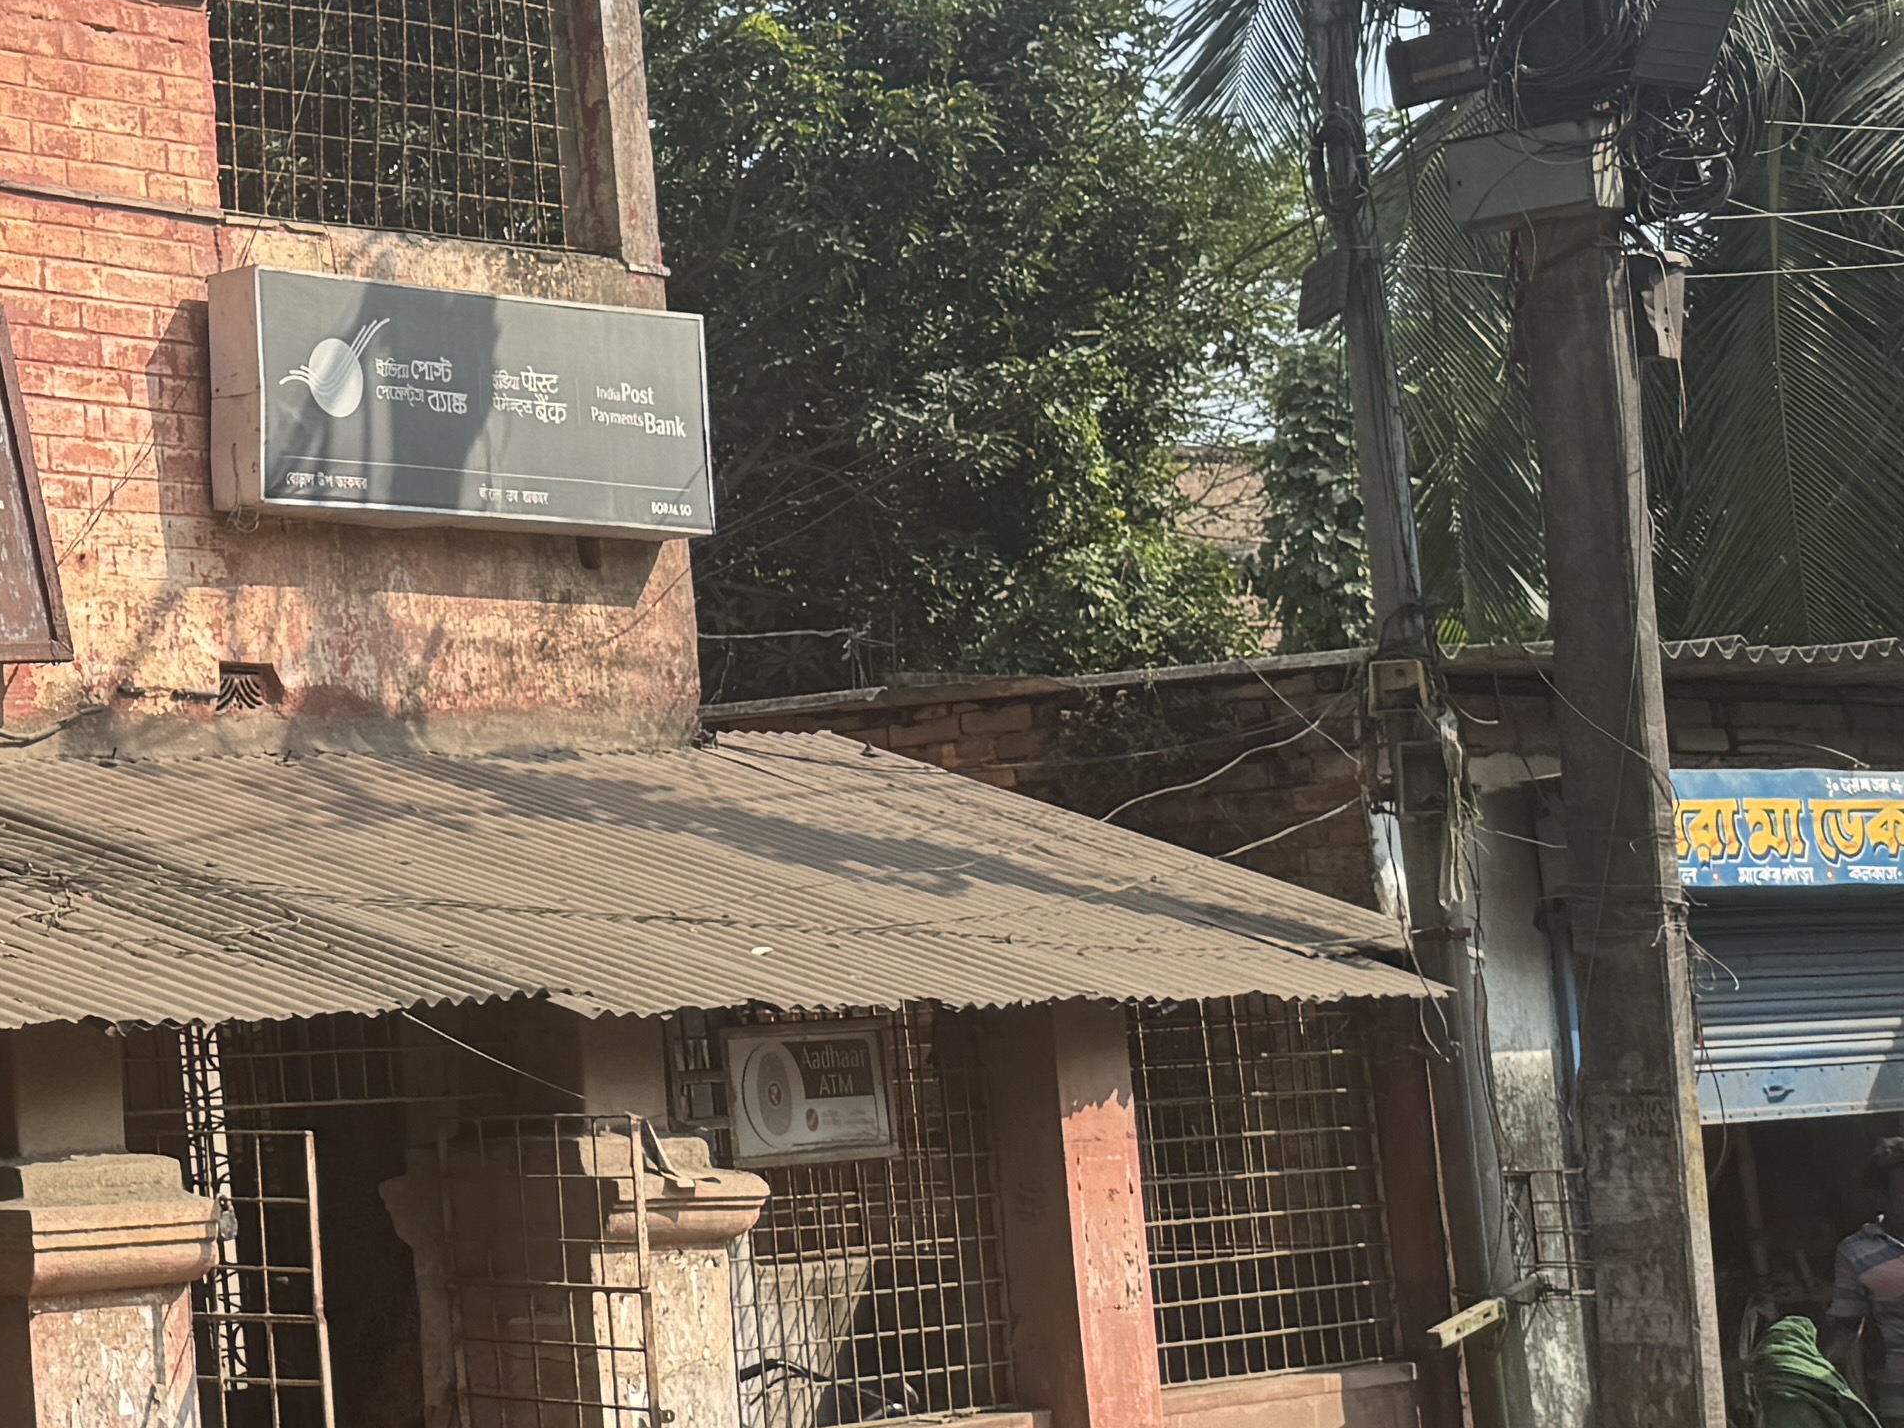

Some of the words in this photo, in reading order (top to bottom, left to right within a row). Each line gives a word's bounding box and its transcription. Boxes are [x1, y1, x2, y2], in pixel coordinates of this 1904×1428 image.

[411, 357, 452, 383] পোস্ট
[520, 365, 559, 394] पोस्ट
[596, 385, 621, 402] India
[620, 382, 655, 405] Post
[533, 393, 568, 424] बैंक
[590, 406, 644, 427] Payments
[643, 412, 687, 437] Bank
[1743, 797, 1802, 858] মা
[802, 1043, 868, 1070] Aadhaar
[819, 1073, 855, 1096] ATM
